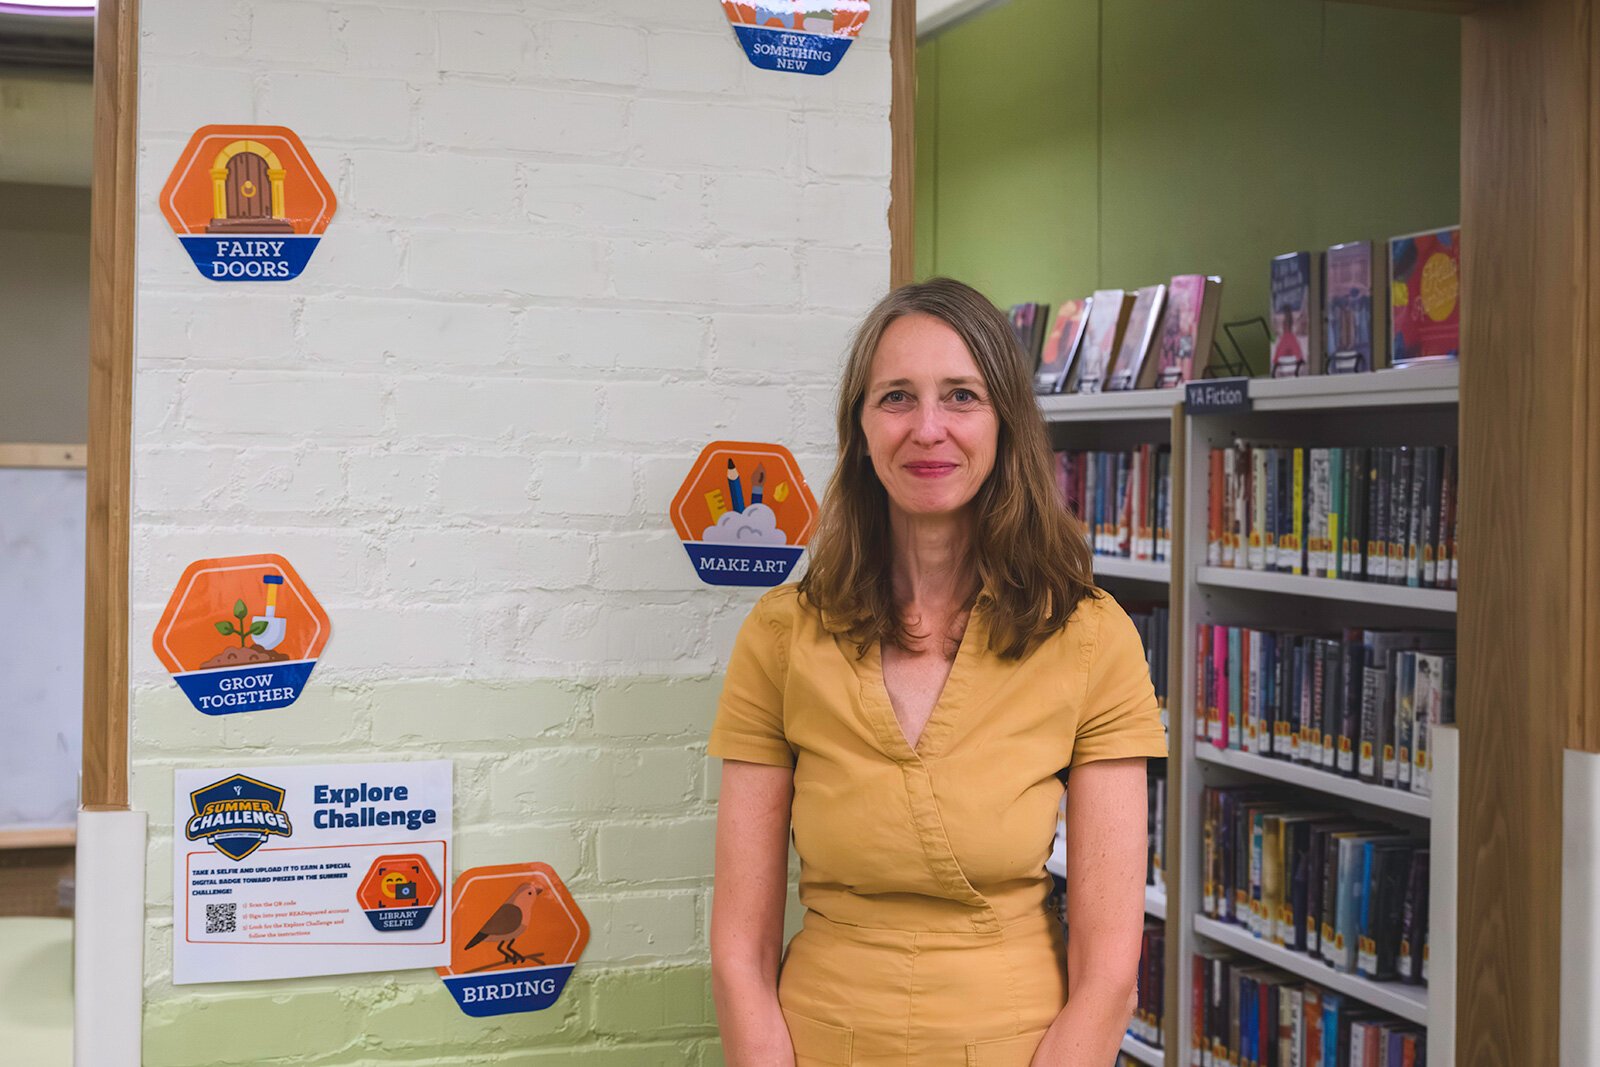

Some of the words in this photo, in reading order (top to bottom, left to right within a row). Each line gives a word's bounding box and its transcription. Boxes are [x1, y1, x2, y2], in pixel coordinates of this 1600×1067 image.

[780, 34, 807, 47] TRY
[753, 43, 832, 62] SOMETHING
[776, 58, 808, 71] NEW
[216, 241, 285, 257] FAIRY
[212, 261, 290, 277] DOORS
[1189, 387, 1205, 406] YA
[1206, 386, 1243, 405] Fiction
[699, 557, 750, 572] MAKE
[752, 560, 787, 573] ART
[218, 673, 274, 691] GROW
[199, 687, 295, 709] TOGETHER
[313, 783, 409, 808] Explore
[205, 801, 272, 815] SUMMER
[189, 811, 288, 832] CHALLENGE
[313, 807, 437, 830] Challenge
[319, 872, 348, 880] SUMMER
[192, 888, 232, 896] CHALLENGE!
[378, 910, 419, 920] LIBRARY
[383, 919, 414, 928] SELFIE
[462, 979, 556, 1003] BIRDING
